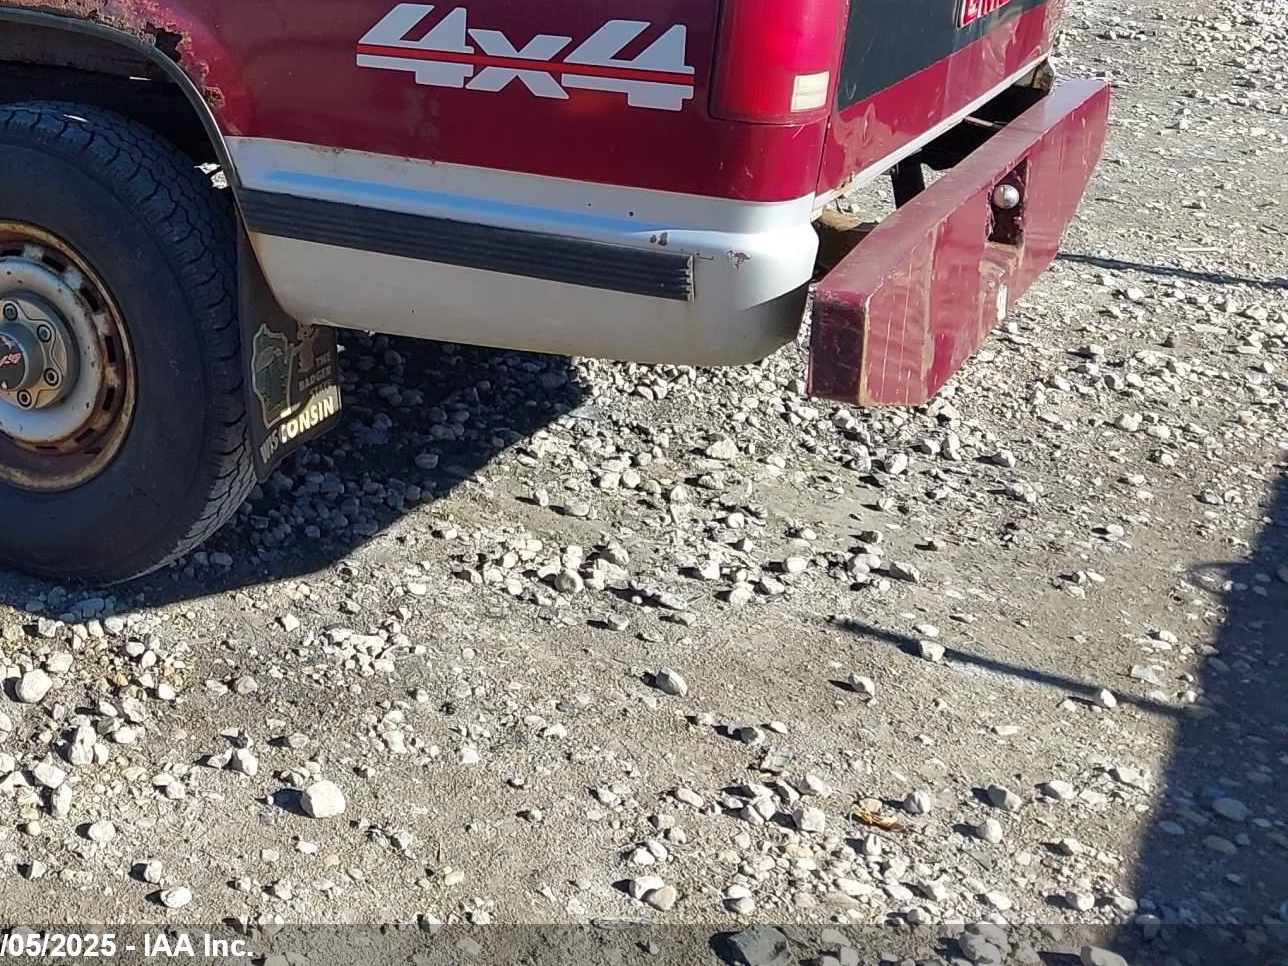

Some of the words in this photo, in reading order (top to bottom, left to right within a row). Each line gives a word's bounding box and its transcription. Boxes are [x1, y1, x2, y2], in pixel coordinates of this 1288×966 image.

[356, 2, 696, 113] 4x4
[298, 366, 333, 392] BADGER
[315, 351, 332, 367] THE
[260, 395, 335, 464] WISCONSIN
